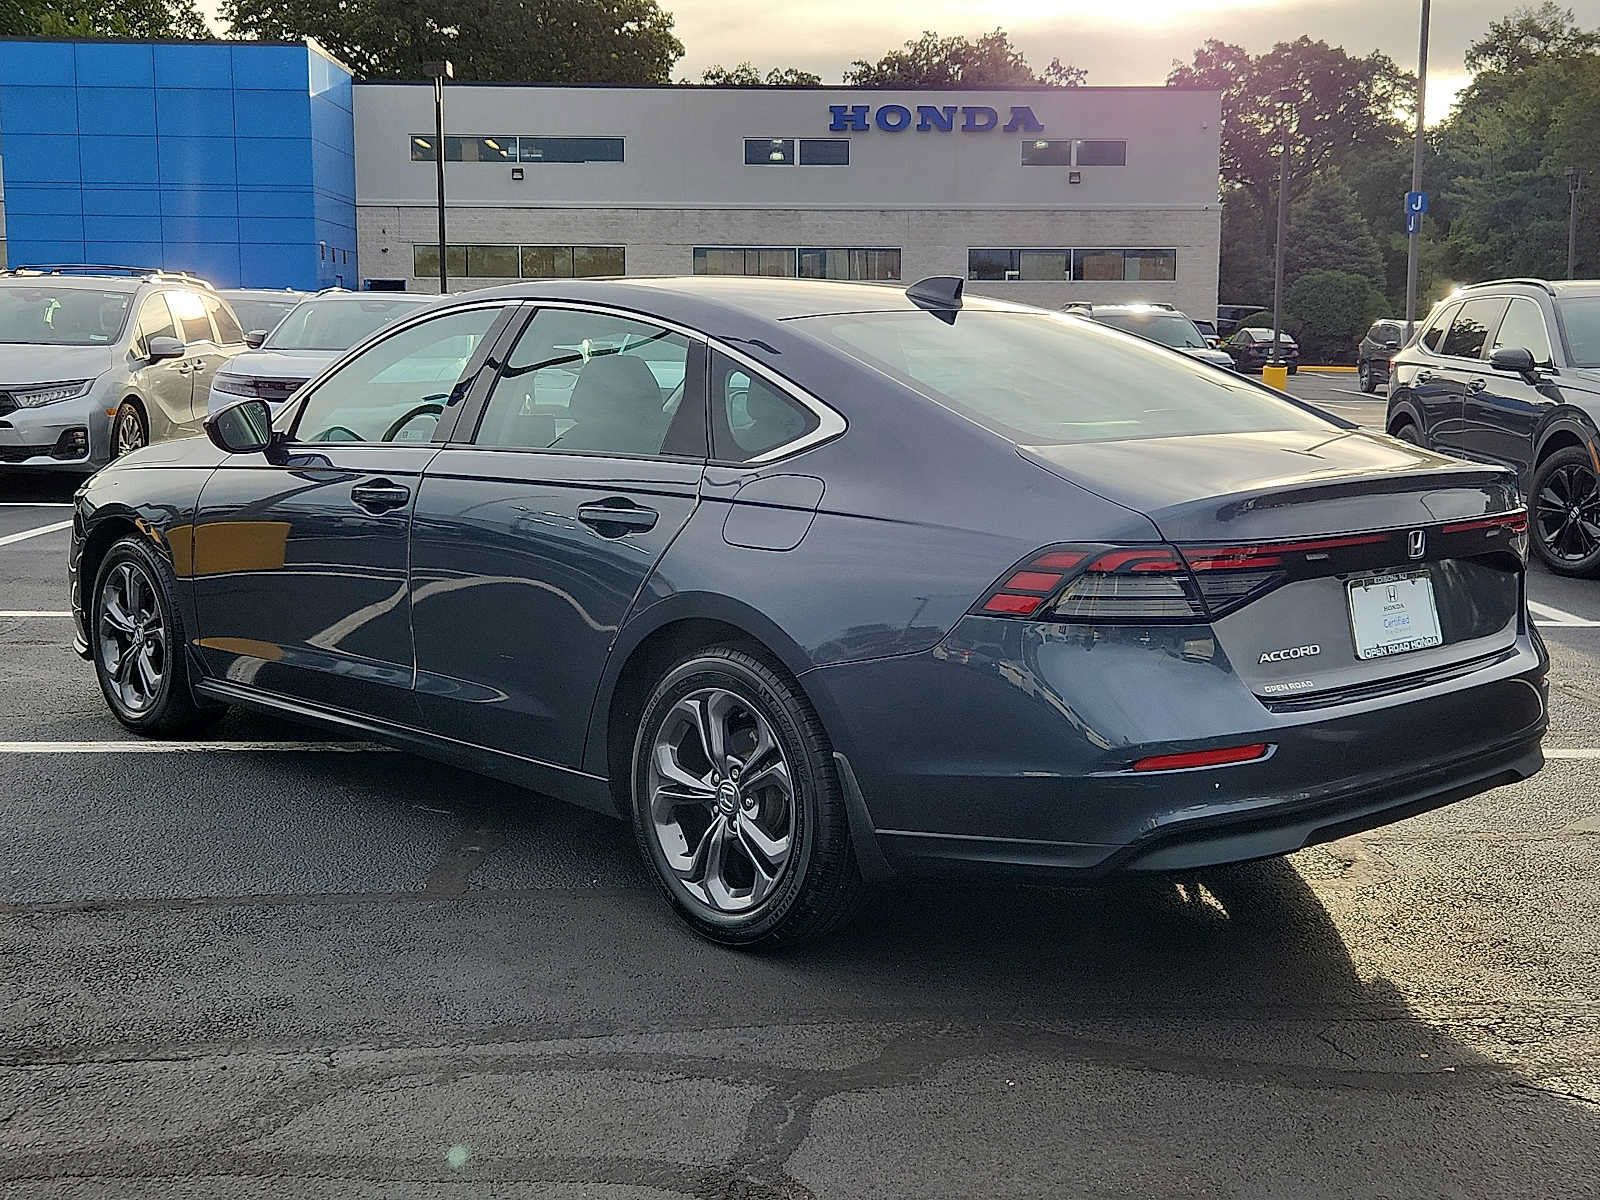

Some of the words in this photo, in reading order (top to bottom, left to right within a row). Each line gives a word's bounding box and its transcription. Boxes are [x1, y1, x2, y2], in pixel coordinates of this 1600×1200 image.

[829, 104, 1044, 132] HONDA
[1411, 195, 1422, 211] J
[1408, 215, 1414, 232] J
[1383, 603, 1405, 611] HONDA
[1383, 615, 1410, 629] Certified
[1259, 644, 1320, 663] ACCORD
[1365, 646, 1388, 658] OPEN
[1388, 643, 1410, 654] ROAD
[1410, 637, 1438, 650] HONDA
[1264, 683, 1289, 693] OPEN
[1289, 681, 1313, 690] ROAD
